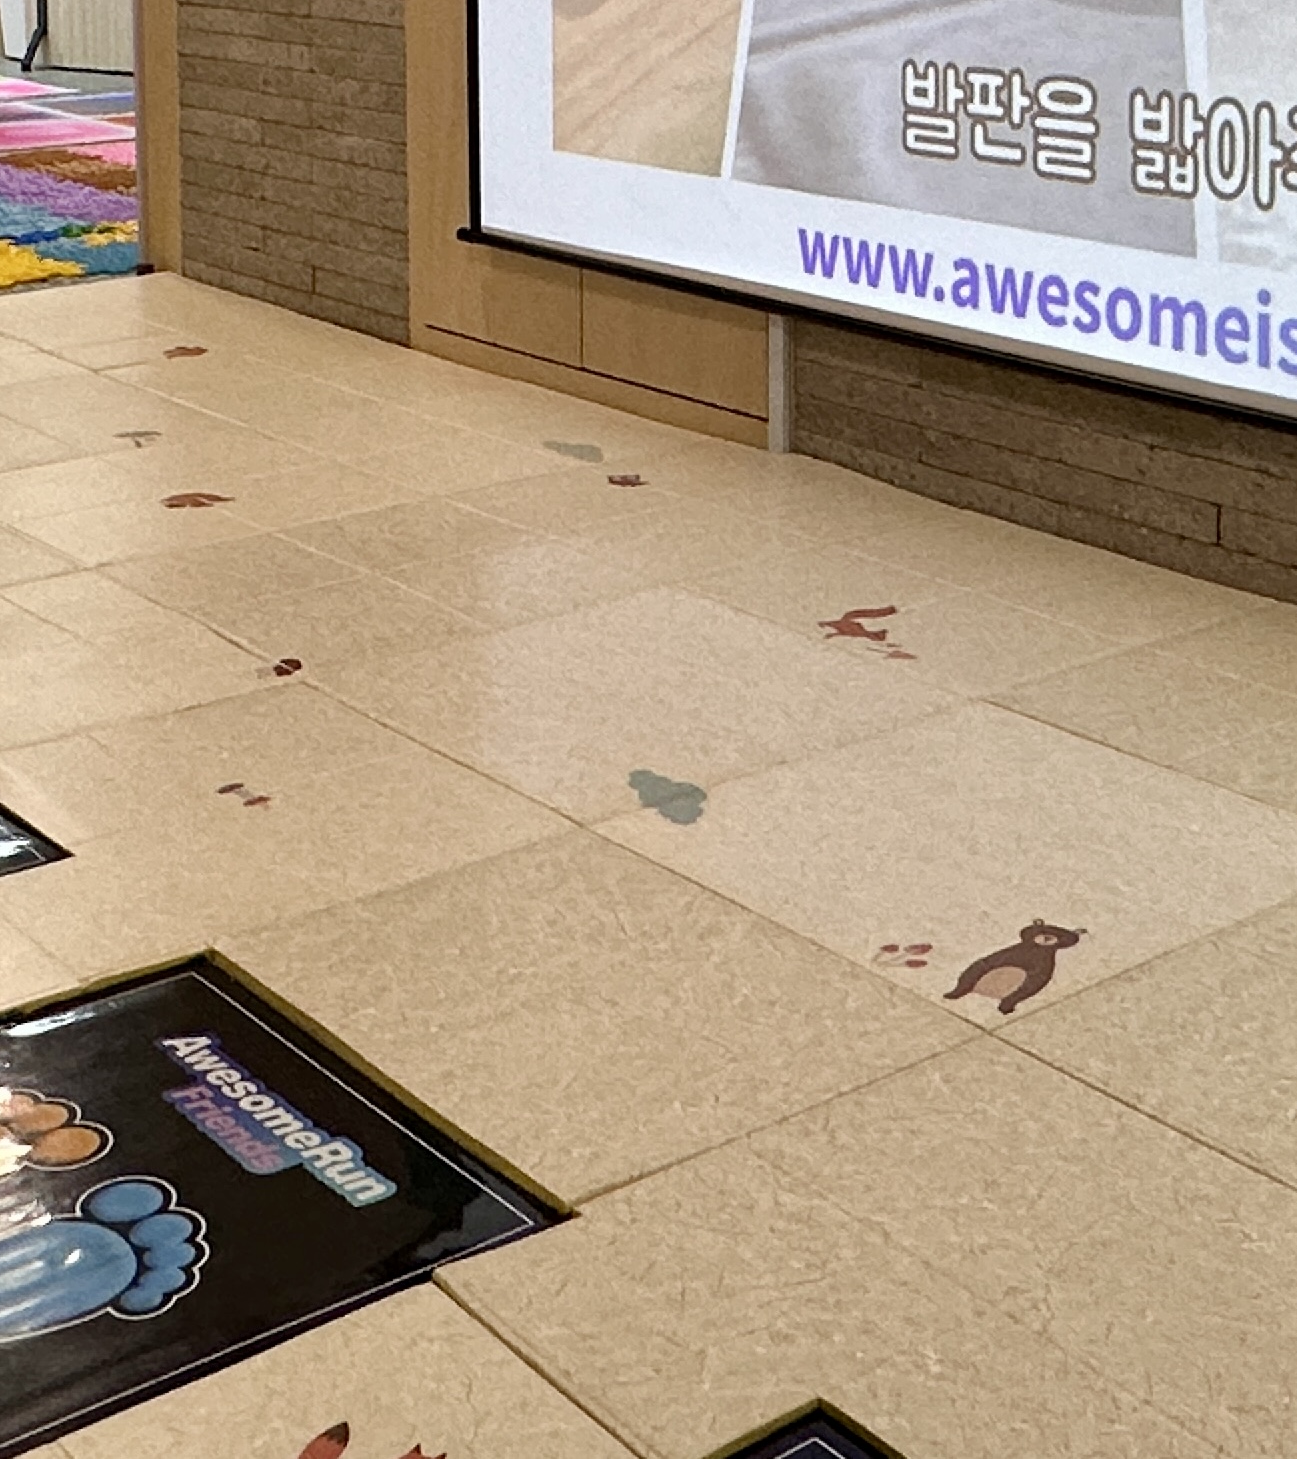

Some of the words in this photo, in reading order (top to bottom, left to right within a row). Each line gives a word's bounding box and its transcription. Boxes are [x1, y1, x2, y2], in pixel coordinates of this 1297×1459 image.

[903, 60, 1099, 183] 발판을
[161, 1036, 388, 1200] AwesomeRun
[170, 1083, 284, 1171] Friends
